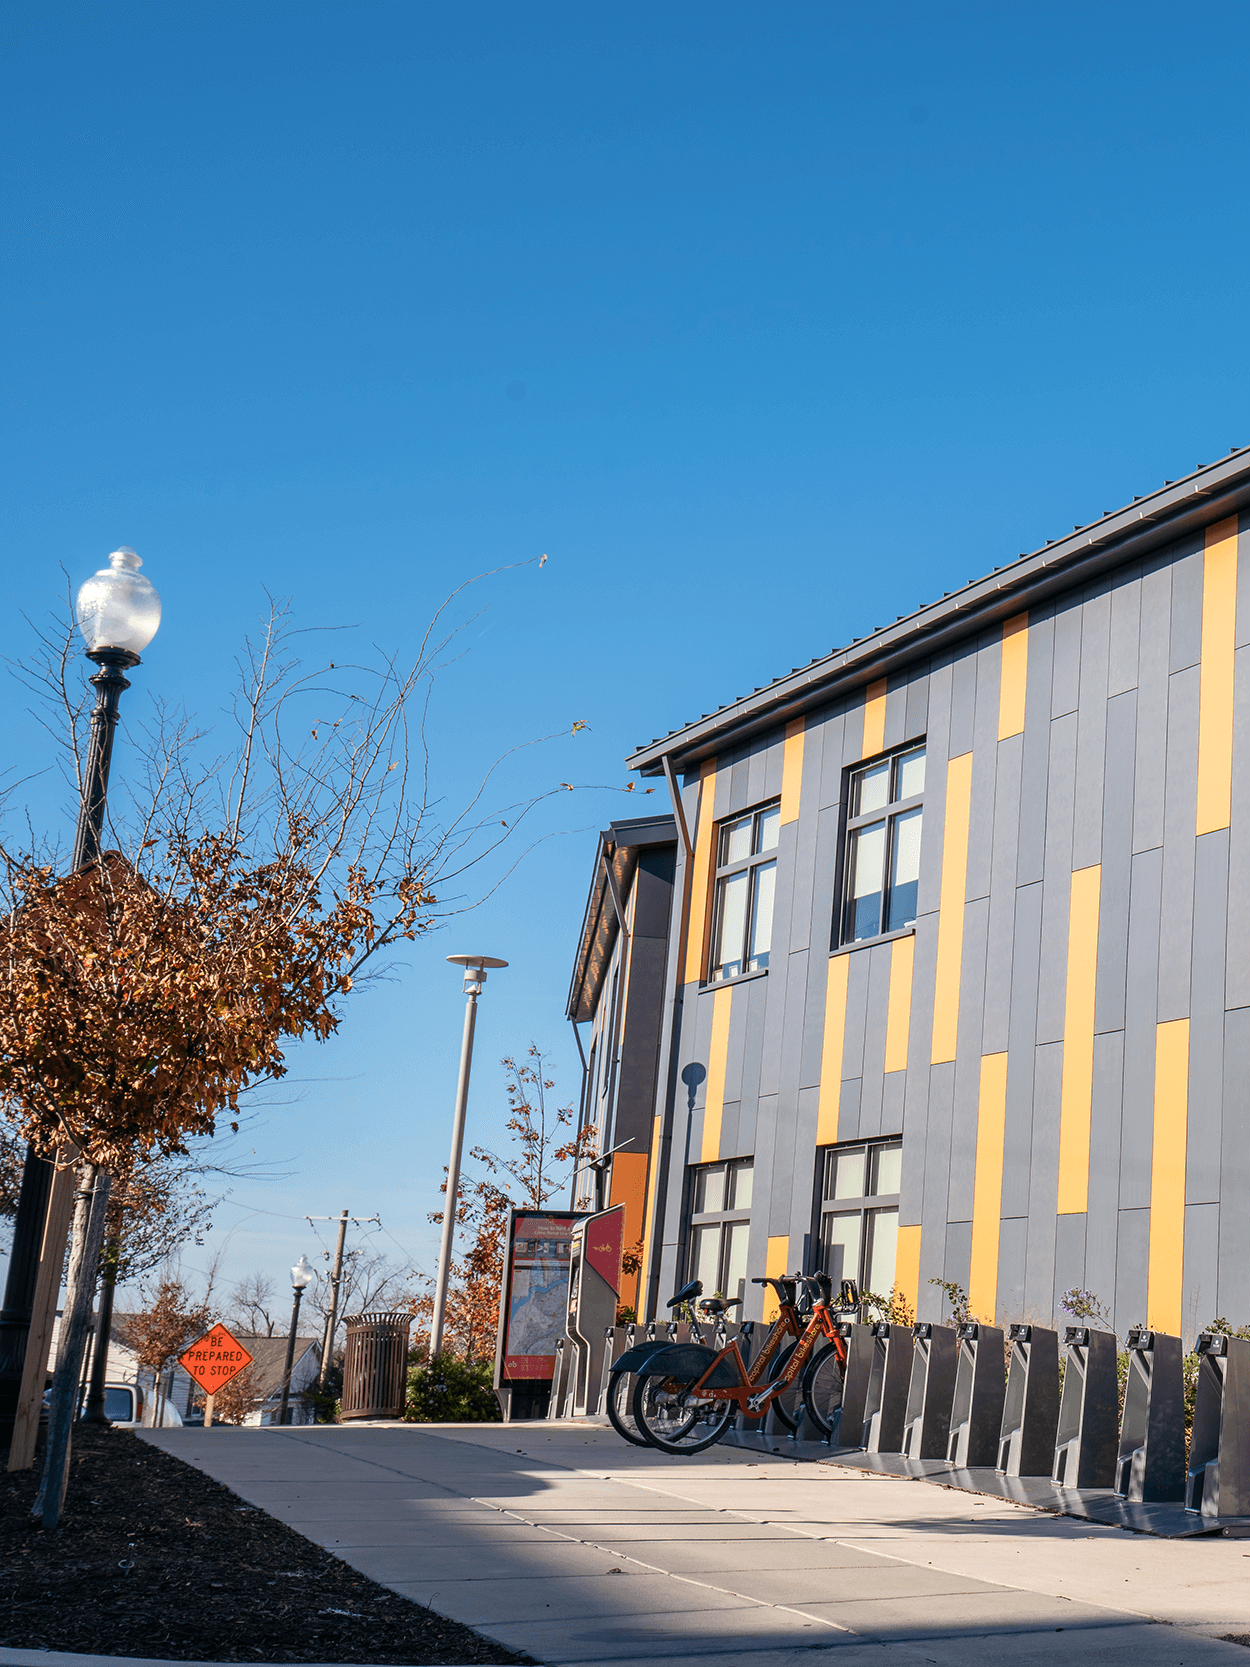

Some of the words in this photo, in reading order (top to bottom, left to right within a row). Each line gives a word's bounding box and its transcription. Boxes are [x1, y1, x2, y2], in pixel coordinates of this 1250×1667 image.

[211, 1337, 223, 1347] BE
[188, 1351, 242, 1361] PREPARED
[749, 1355, 766, 1381] capital
[762, 1321, 786, 1355] bikeshare
[785, 1358, 799, 1381] apital
[796, 1323, 820, 1358] bikeshare
[193, 1366, 205, 1375] TO
[210, 1366, 236, 1375] STOP
